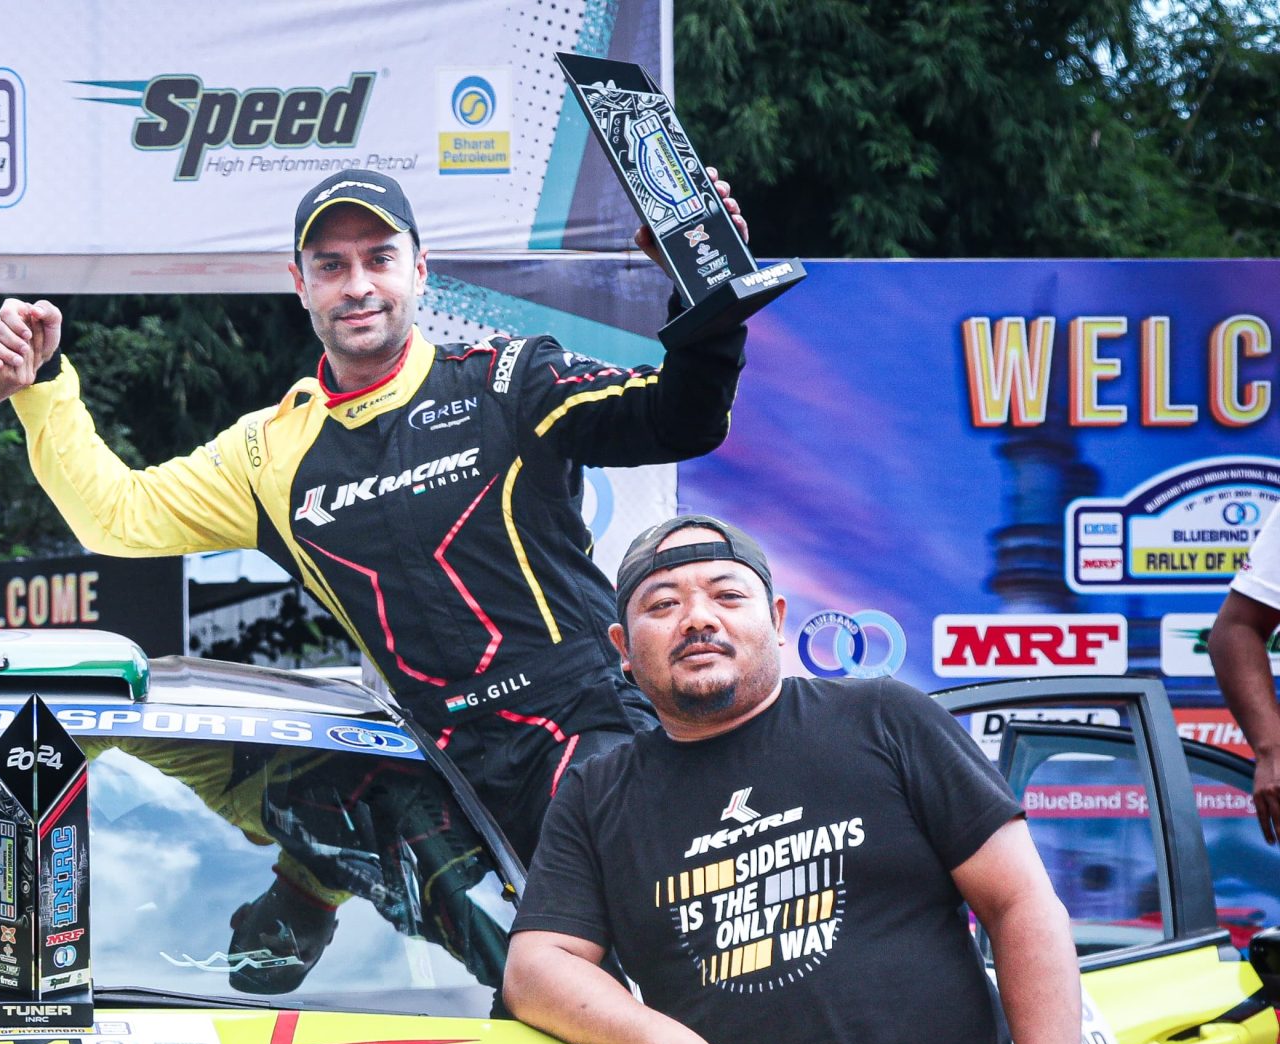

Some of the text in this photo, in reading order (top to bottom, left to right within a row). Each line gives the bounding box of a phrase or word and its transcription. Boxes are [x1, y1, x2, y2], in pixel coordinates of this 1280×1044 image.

[131, 71, 377, 182] Speed
[442, 150, 508, 165] Petroleum
[452, 137, 496, 151] Bharat
[205, 153, 419, 174] High Performance Petrol
[742, 263, 794, 287] WINNER
[962, 314, 1272, 427] WELC
[422, 397, 478, 424] BREN
[331, 447, 480, 511] JK RACING
[429, 467, 481, 490] INDIA
[1173, 530, 1249, 542] BLUEBAND
[1146, 552, 1198, 571] RALLY
[1205, 552, 1226, 570] OF
[941, 625, 1119, 666] MRF
[56, 709, 314, 743] SPORTS
[1024, 792, 1122, 811] BlueBand
[735, 817, 866, 883] SIDEWAYS
[51, 827, 77, 925] INRC
[679, 881, 759, 934] IS THE
[45, 928, 85, 947] MRF
[716, 904, 782, 950] ONLY
[779, 920, 838, 962] WAY
[2, 1005, 72, 1016] TUNER
